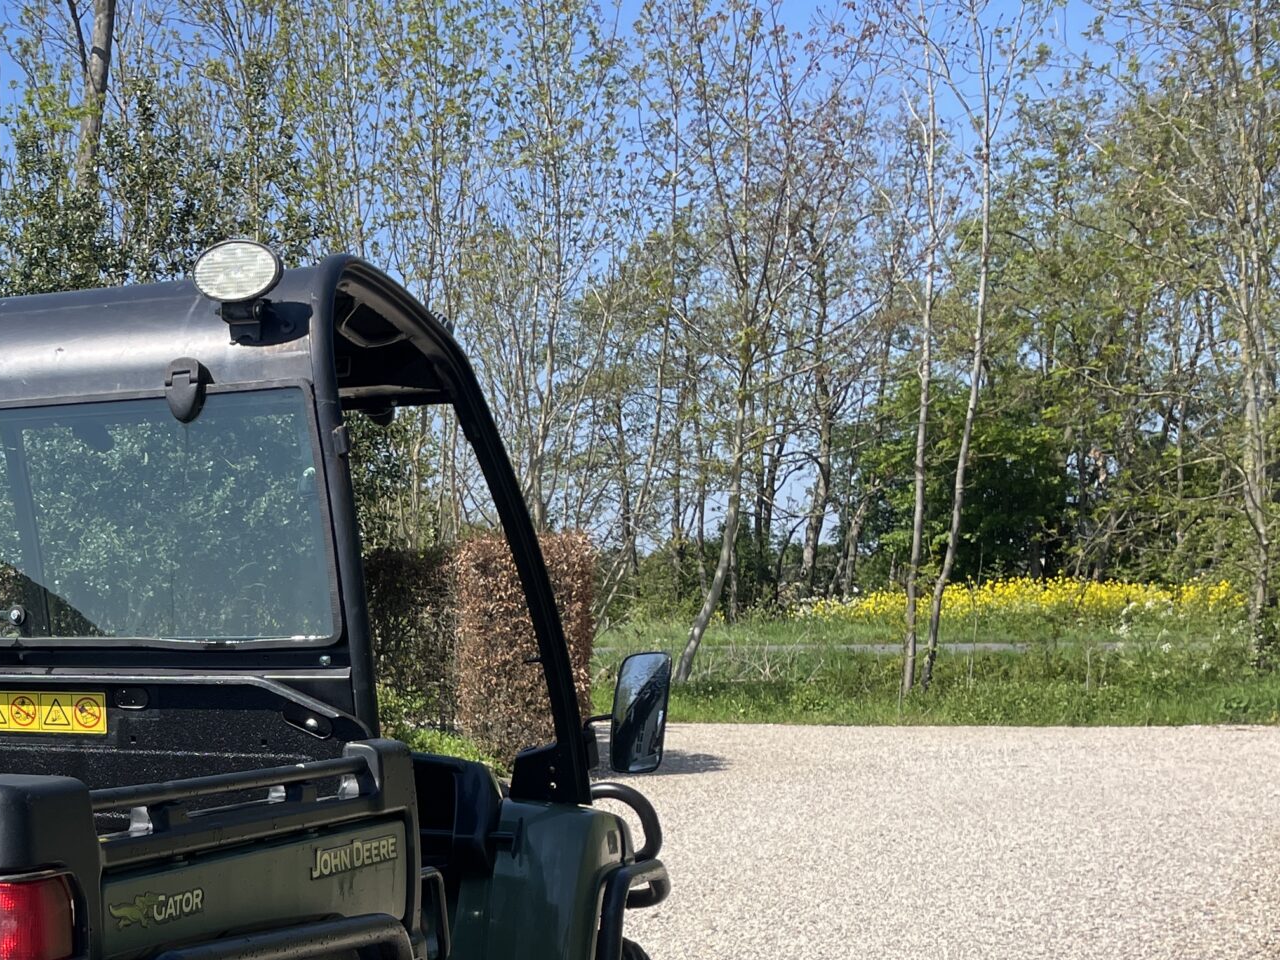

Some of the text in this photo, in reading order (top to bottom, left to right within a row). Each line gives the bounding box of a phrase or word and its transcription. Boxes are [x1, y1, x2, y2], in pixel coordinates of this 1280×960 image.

[312, 836, 397, 879] JOHN DEERE
[153, 888, 203, 921] GATOR
